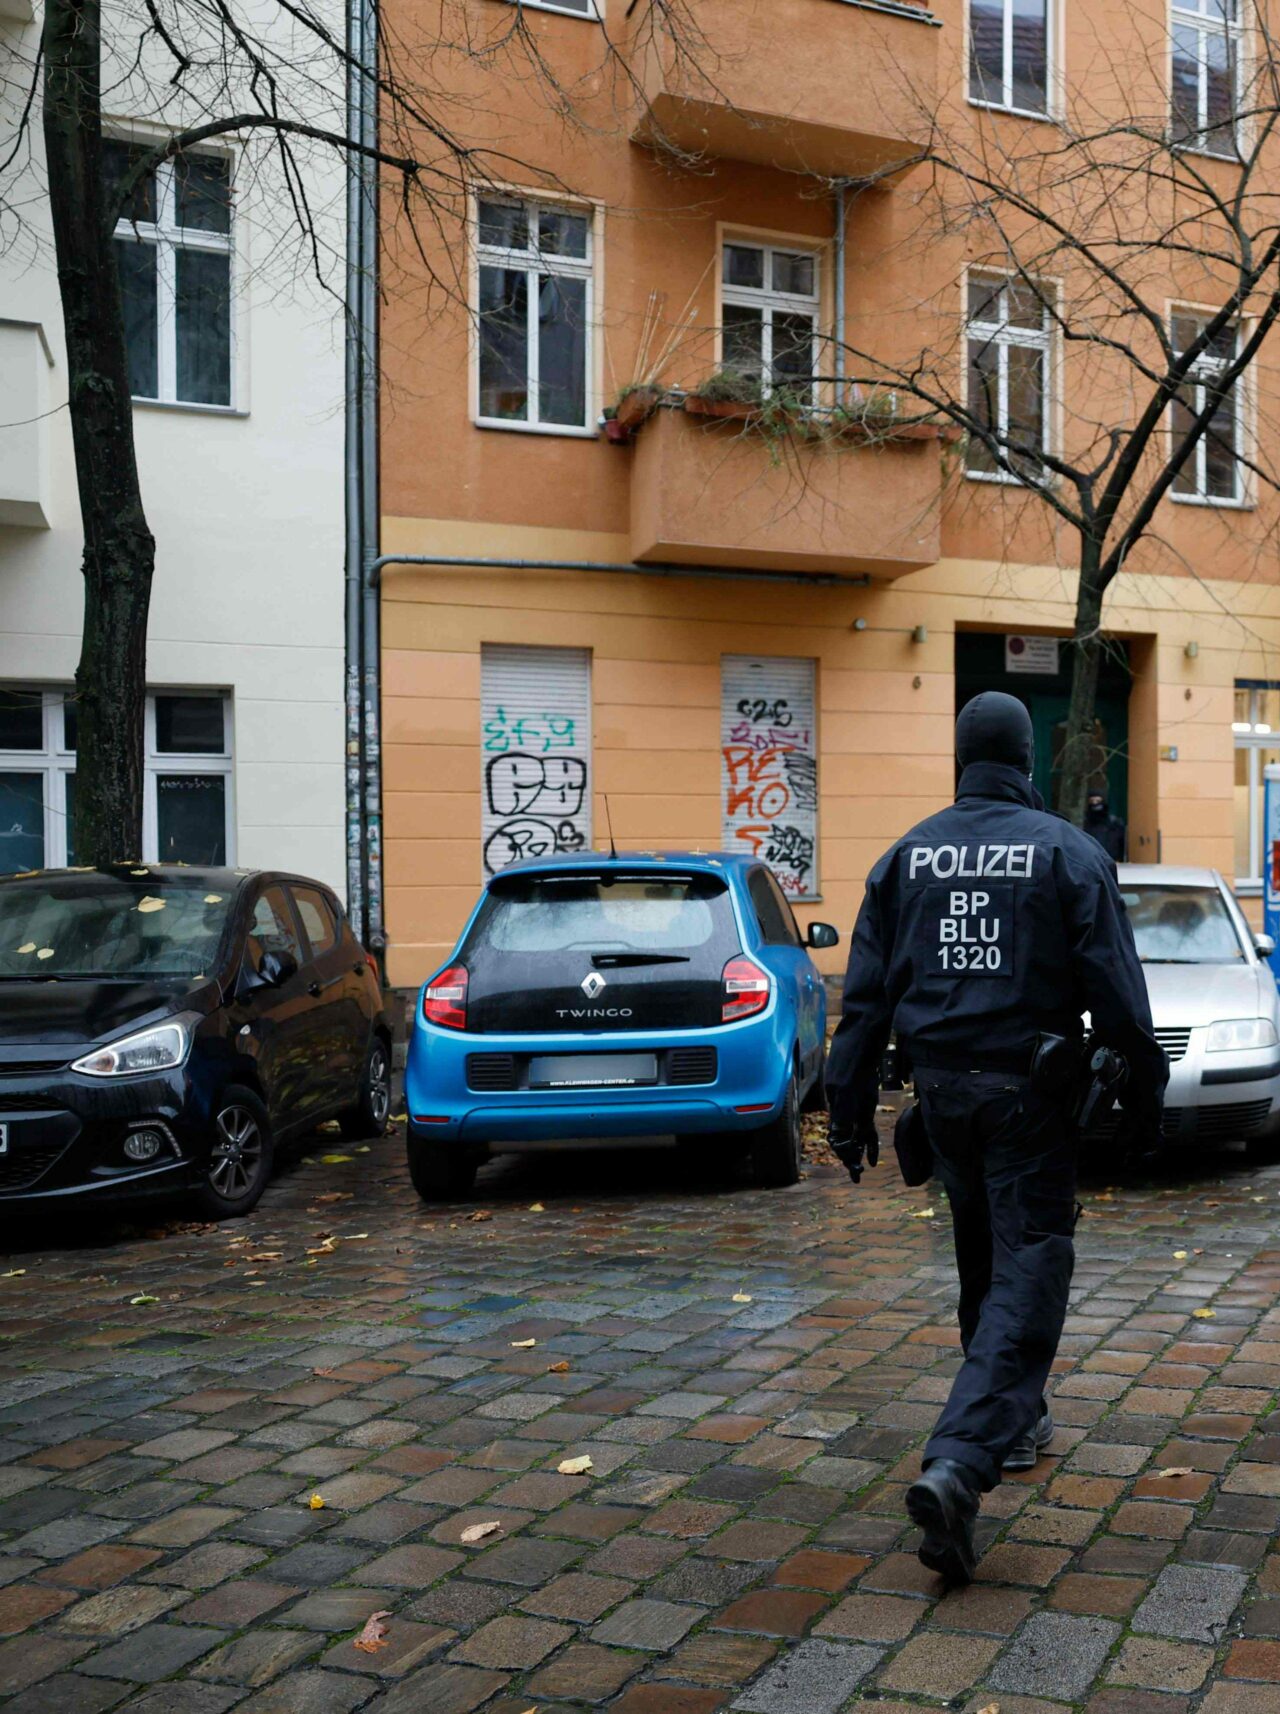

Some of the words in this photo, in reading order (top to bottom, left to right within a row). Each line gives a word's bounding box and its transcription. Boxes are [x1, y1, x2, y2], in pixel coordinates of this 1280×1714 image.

[908, 844, 1035, 880] POLIZEI
[949, 891, 990, 916] BP
[939, 918, 1000, 943] BLU
[937, 945, 1001, 970] 1320
[555, 1008, 633, 1018] TWINGO
